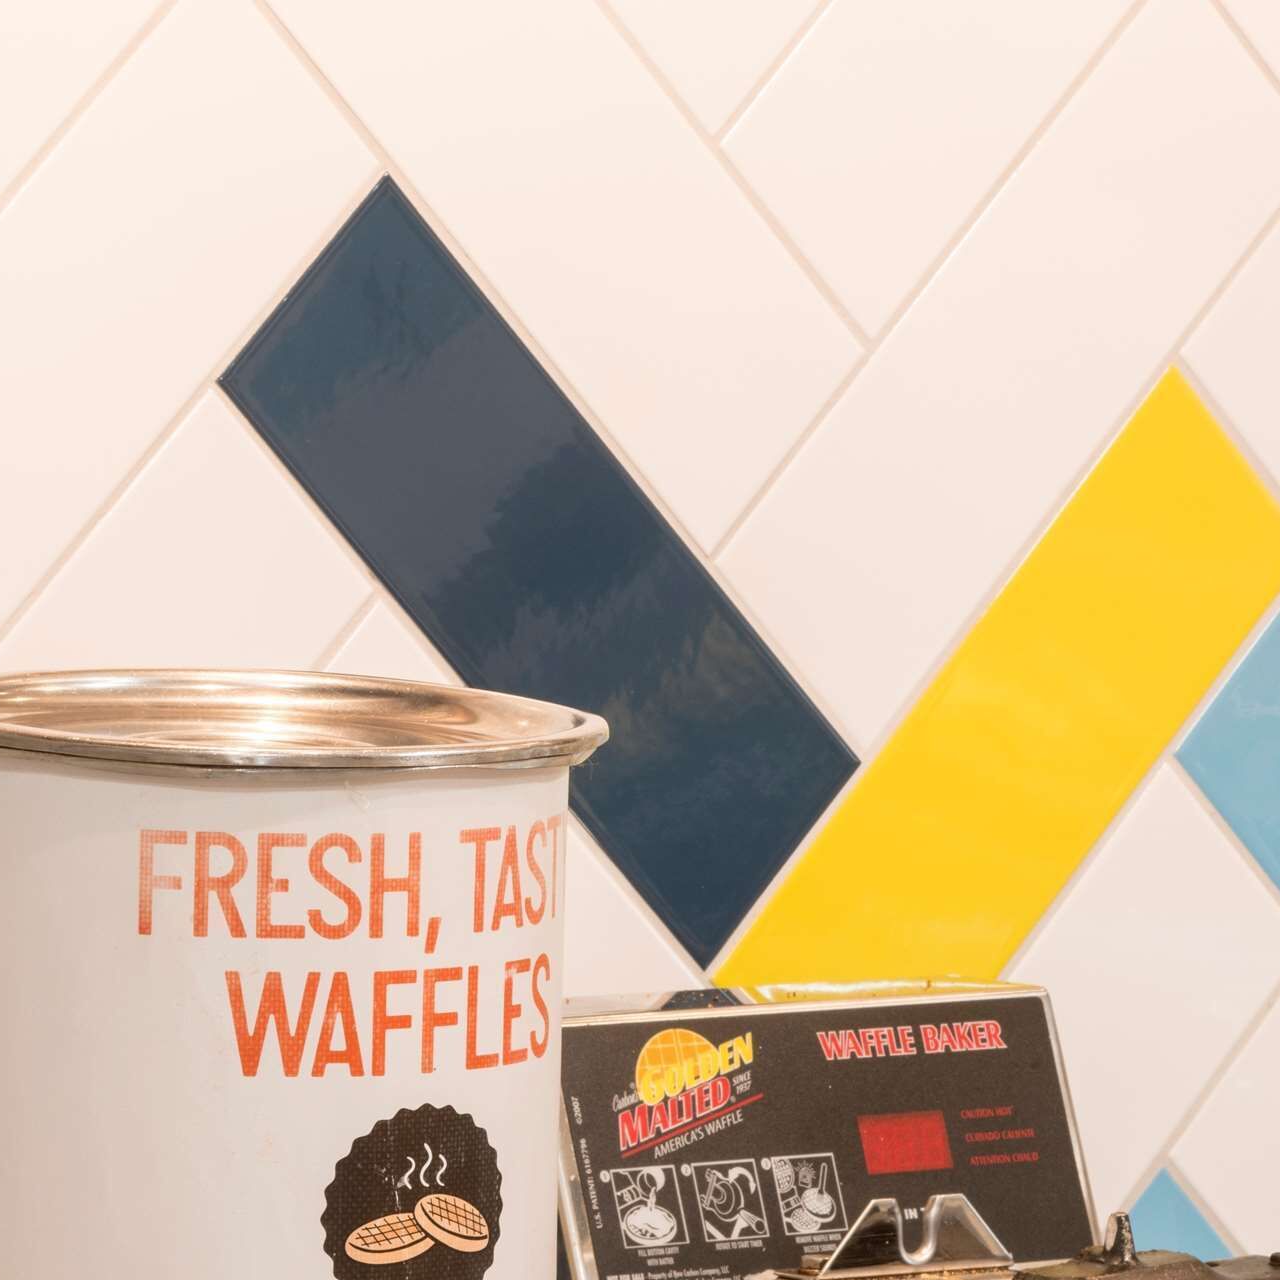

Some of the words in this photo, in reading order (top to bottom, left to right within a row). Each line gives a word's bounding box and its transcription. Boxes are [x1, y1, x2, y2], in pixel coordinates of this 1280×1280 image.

[138, 828, 441, 954] FRESH,
[225, 953, 551, 1077] WAFFLES
[816, 1026, 917, 1061] WAFFLE
[920, 1020, 1008, 1054] BAKER
[641, 1031, 753, 1105] GOLDEN
[732, 1071, 752, 1087] SINCE
[618, 1076, 731, 1150] MALTED
[654, 1128, 705, 1159] AMERICA'S
[705, 1109, 744, 1136] WAFFLE
